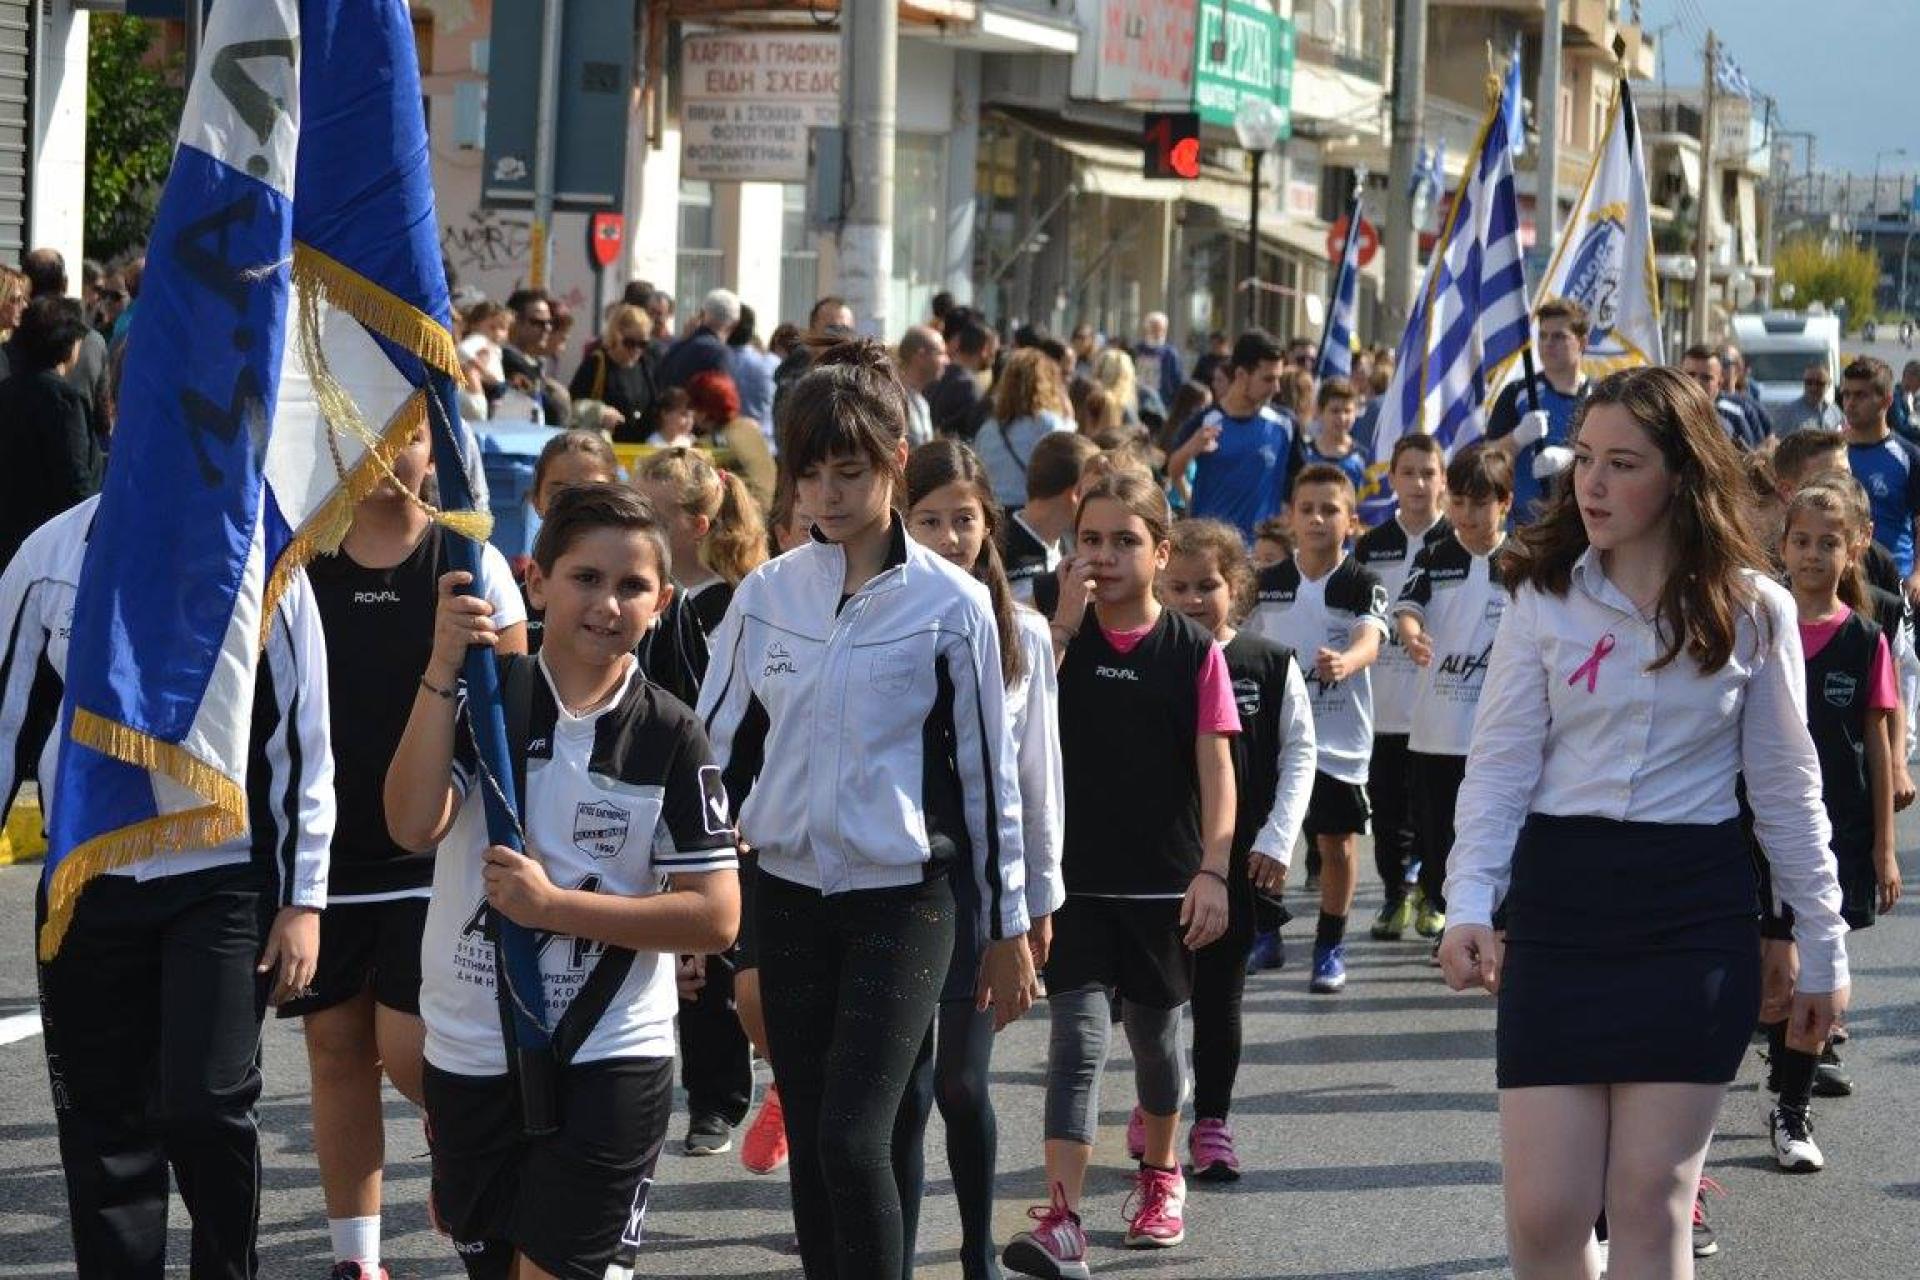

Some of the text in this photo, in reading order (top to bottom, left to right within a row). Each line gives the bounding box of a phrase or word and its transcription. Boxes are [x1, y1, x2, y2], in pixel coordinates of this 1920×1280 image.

[706, 70, 755, 92] ΕΙΔΗ
[354, 591, 400, 603] ROYAL
[1096, 665, 1139, 681] ROYAL
